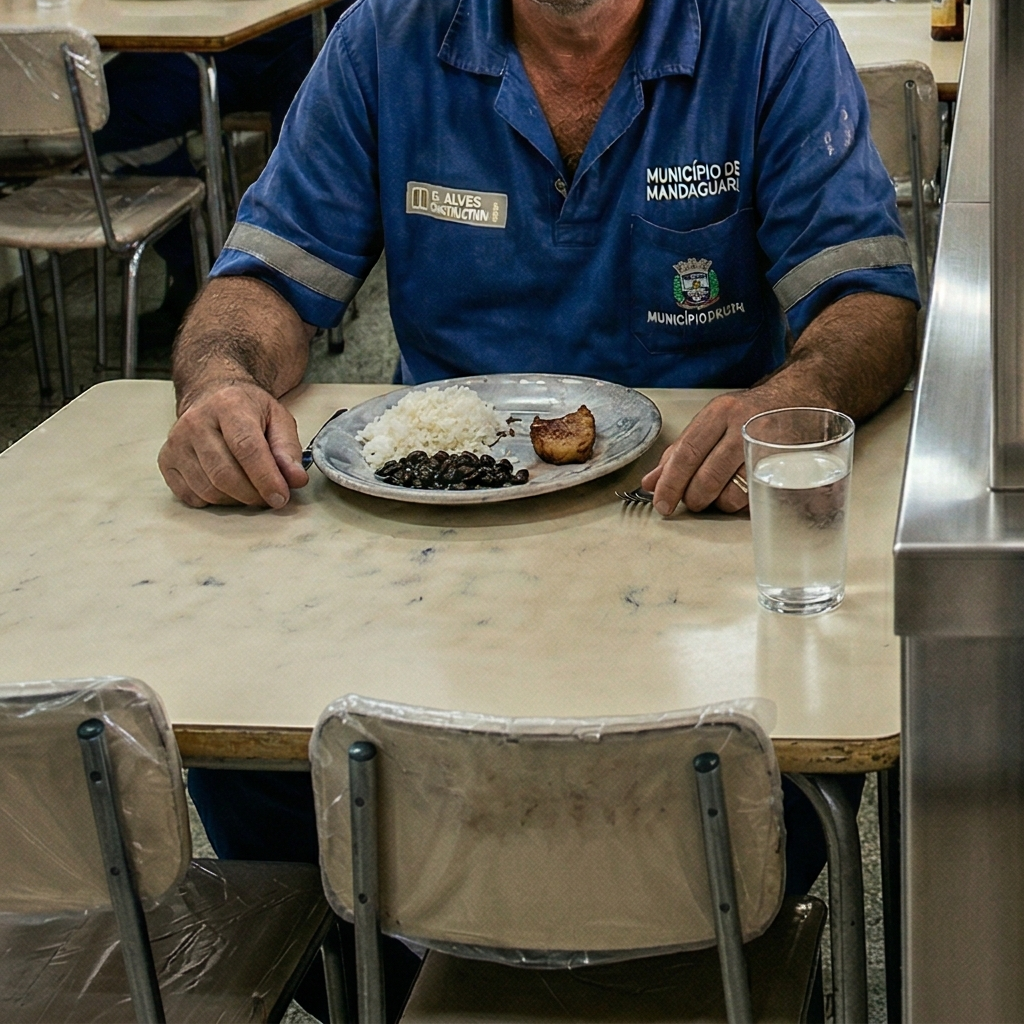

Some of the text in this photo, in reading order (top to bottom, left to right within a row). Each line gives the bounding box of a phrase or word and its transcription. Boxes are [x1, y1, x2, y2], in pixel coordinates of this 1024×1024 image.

[646, 159, 740, 184] MUNICÍPIO DE
[444, 192, 482, 208] ALVES
